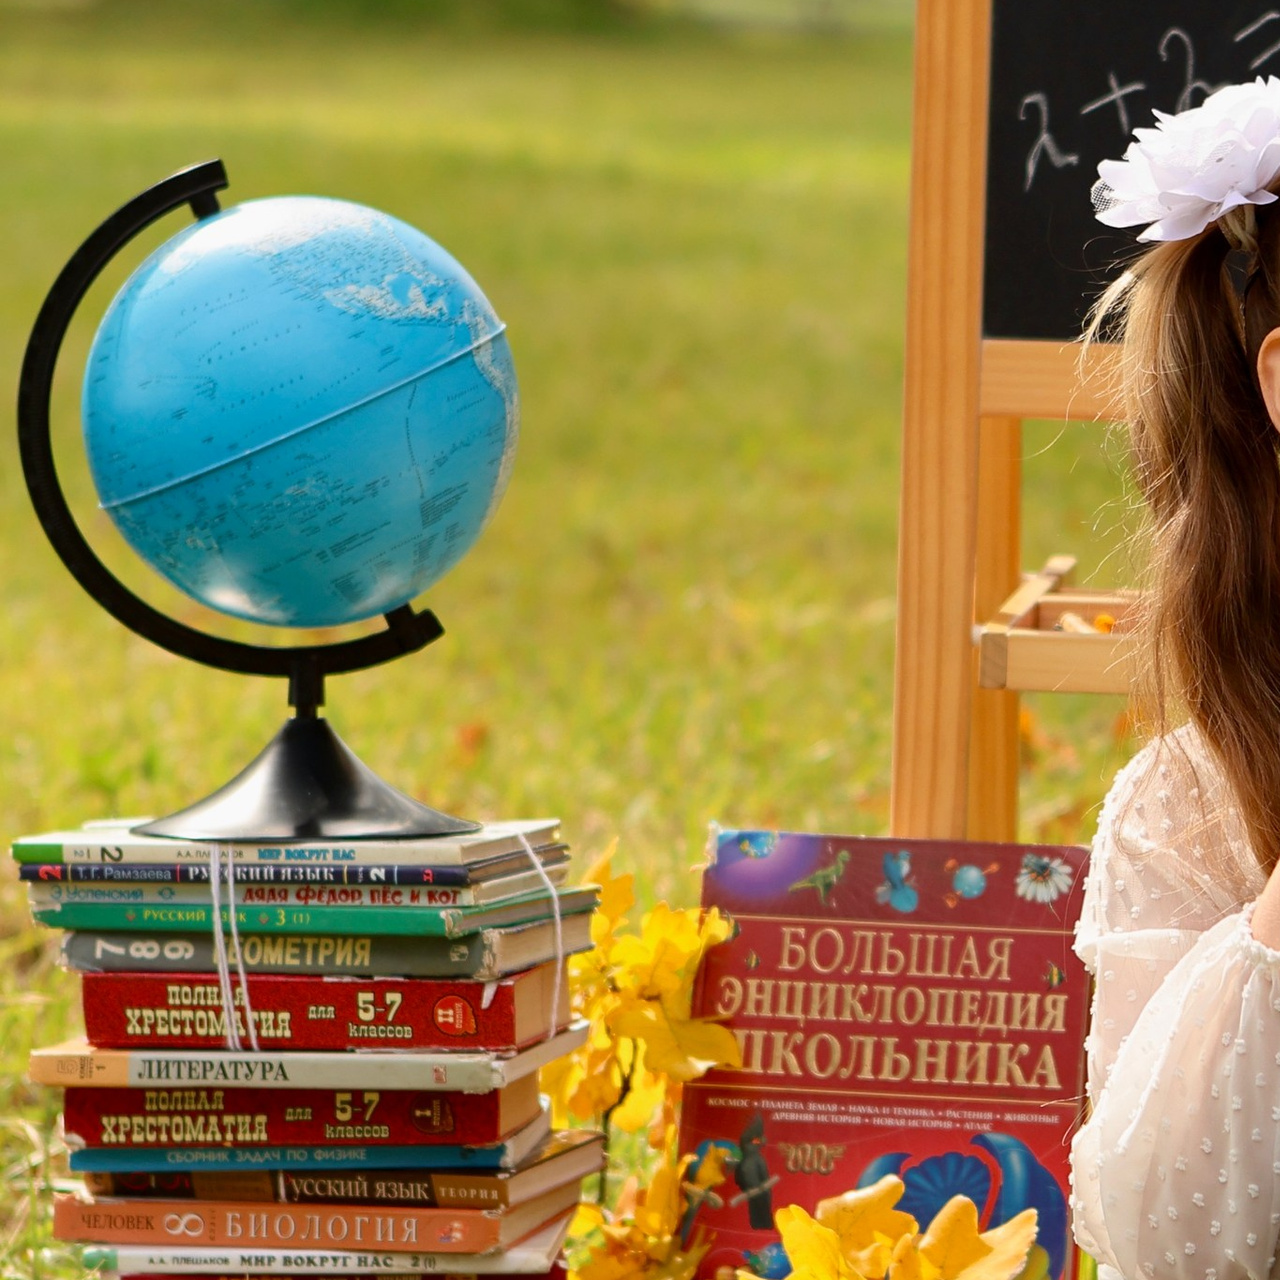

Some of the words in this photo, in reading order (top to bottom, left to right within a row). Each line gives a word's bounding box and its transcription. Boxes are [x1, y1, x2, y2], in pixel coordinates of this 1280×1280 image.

[101, 846, 123, 862] 2
[104, 867, 172, 880] Рамзаева
[281, 867, 334, 881] ЯЗЫК
[66, 885, 144, 899] Успенский
[243, 887, 288, 903] ДЯДЯ
[369, 884, 403, 905] ПЁС
[410, 890, 420, 903] И
[427, 889, 462, 904] КОТ
[143, 909, 206, 921] РУССКИЙ
[275, 909, 286, 926] 3
[95, 939, 126, 959] 7
[129, 939, 161, 959] 8
[778, 927, 1015, 981] БОЛЬШАЯ
[308, 1004, 335, 1020] для
[716, 975, 1069, 1038] ЭНЦИКЛОПЕДИЯ
[138, 1059, 290, 1082] ЛИТЕРАТУРА
[144, 1091, 225, 1111] ПОЛНАЯ
[708, 1097, 750, 1108] КОСМОС
[761, 1099, 803, 1111] ПЛАНЕТА
[807, 1102, 838, 1113] ЗЕМЛЯ
[849, 1104, 879, 1115] НАУКА
[893, 1107, 935, 1118] ТЕХНИКА
[946, 1109, 993, 1120] РАСТЕНИЯ
[1004, 1112, 1060, 1125] ЖИВОТНЫЕ
[101, 1114, 268, 1144] ХРЕСТОМАТИЯ
[772, 1111, 815, 1122] ДРЕВНЯЯ
[817, 1114, 861, 1125] ИСТОРИЯ
[873, 1116, 906, 1127] НОВАЯ
[908, 1119, 953, 1130] ИСТОРИЯ
[963, 1121, 994, 1132] АТЛАС
[166, 1150, 229, 1163] СБОРНИК
[236, 1149, 281, 1163] ЗАДАЧ
[286, 1149, 308, 1161] ПО
[313, 1148, 368, 1162] ФИЗИКЕ
[375, 1181, 430, 1200] ЯЗЫК
[438, 1187, 499, 1200] ТЕОРИЯ
[81, 1212, 155, 1231] ЧЕЛОВЕК
[226, 1211, 419, 1243] БИОЛОГИЯ
[172, 1256, 230, 1266] ПЛЕШАКОВ
[240, 1255, 277, 1266] МИР
[283, 1255, 352, 1268] ВОКРУГ
[357, 1256, 395, 1268] НАС
[410, 1256, 421, 1267] 2
